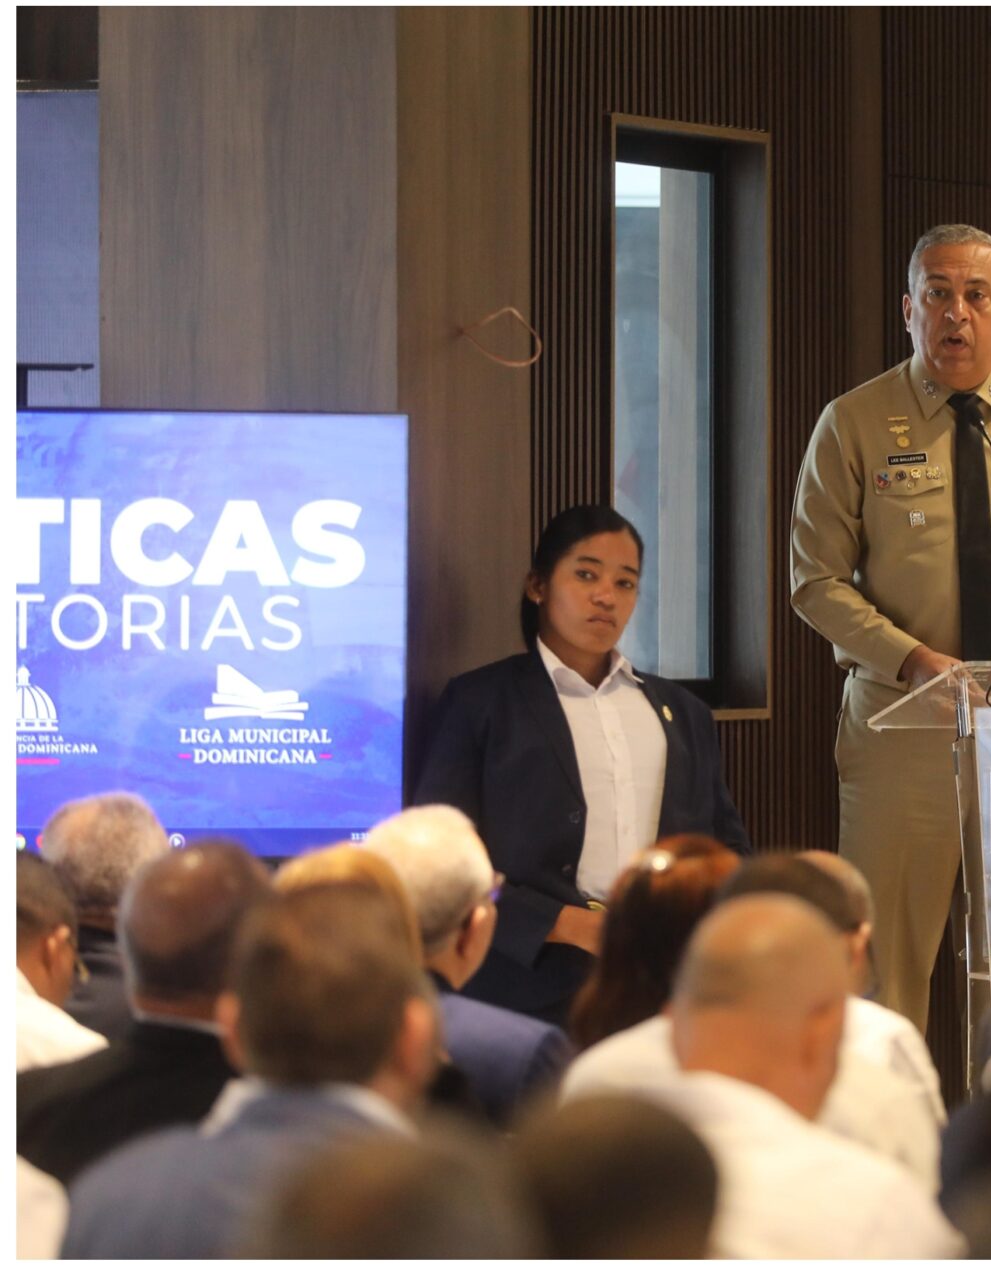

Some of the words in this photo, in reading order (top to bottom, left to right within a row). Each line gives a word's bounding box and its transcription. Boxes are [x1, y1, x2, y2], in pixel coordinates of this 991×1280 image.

[16, 497, 366, 588] TICAS
[16, 594, 303, 651] TORIAS
[179, 728, 224, 744] LIGA
[228, 728, 332, 744] MUNICIPAL
[18, 743, 98, 753] DOMINICANA
[193, 748, 317, 764] DOMINICANA
